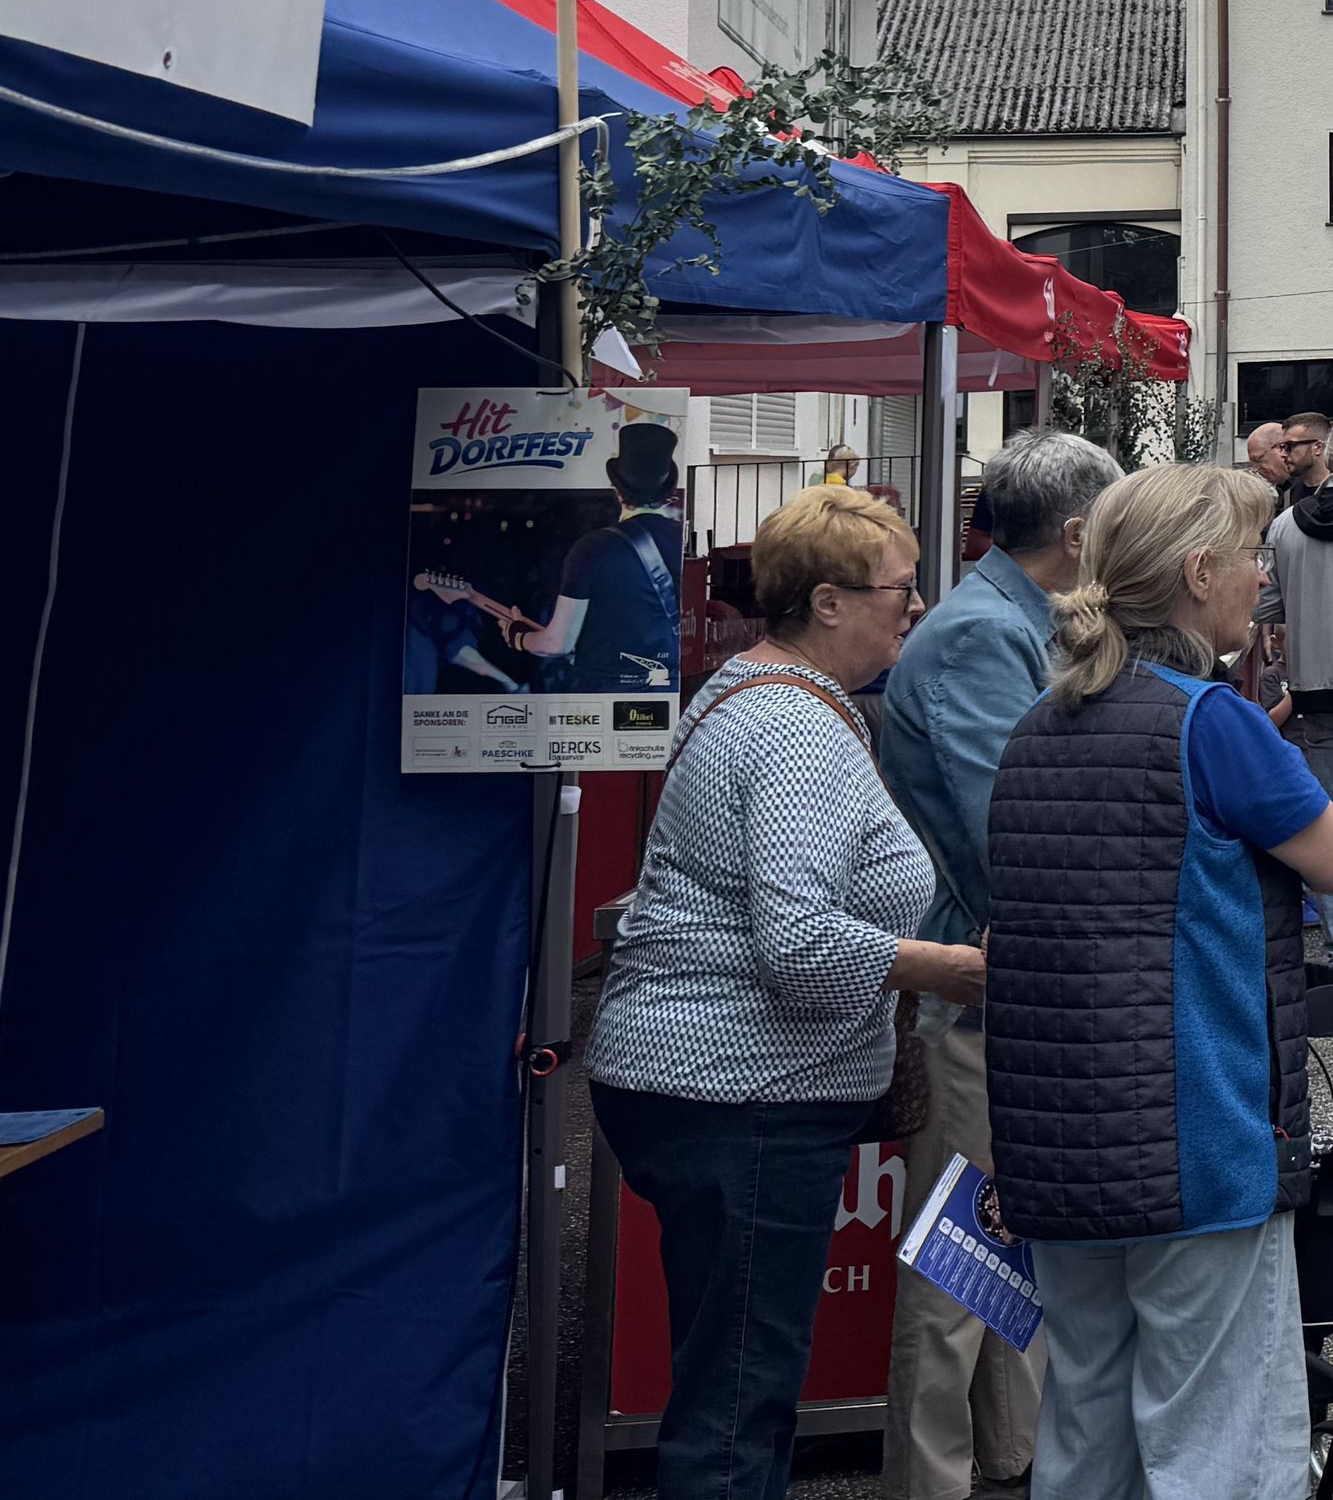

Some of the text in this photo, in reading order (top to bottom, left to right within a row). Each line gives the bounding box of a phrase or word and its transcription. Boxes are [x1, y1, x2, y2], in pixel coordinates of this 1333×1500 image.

[440, 398, 518, 440] Hit
[413, 709, 469, 718] DANKE AN DIE
[557, 714, 600, 725] TESKE
[482, 749, 534, 757] PAESCHKE
[552, 741, 601, 754] DERCKS
